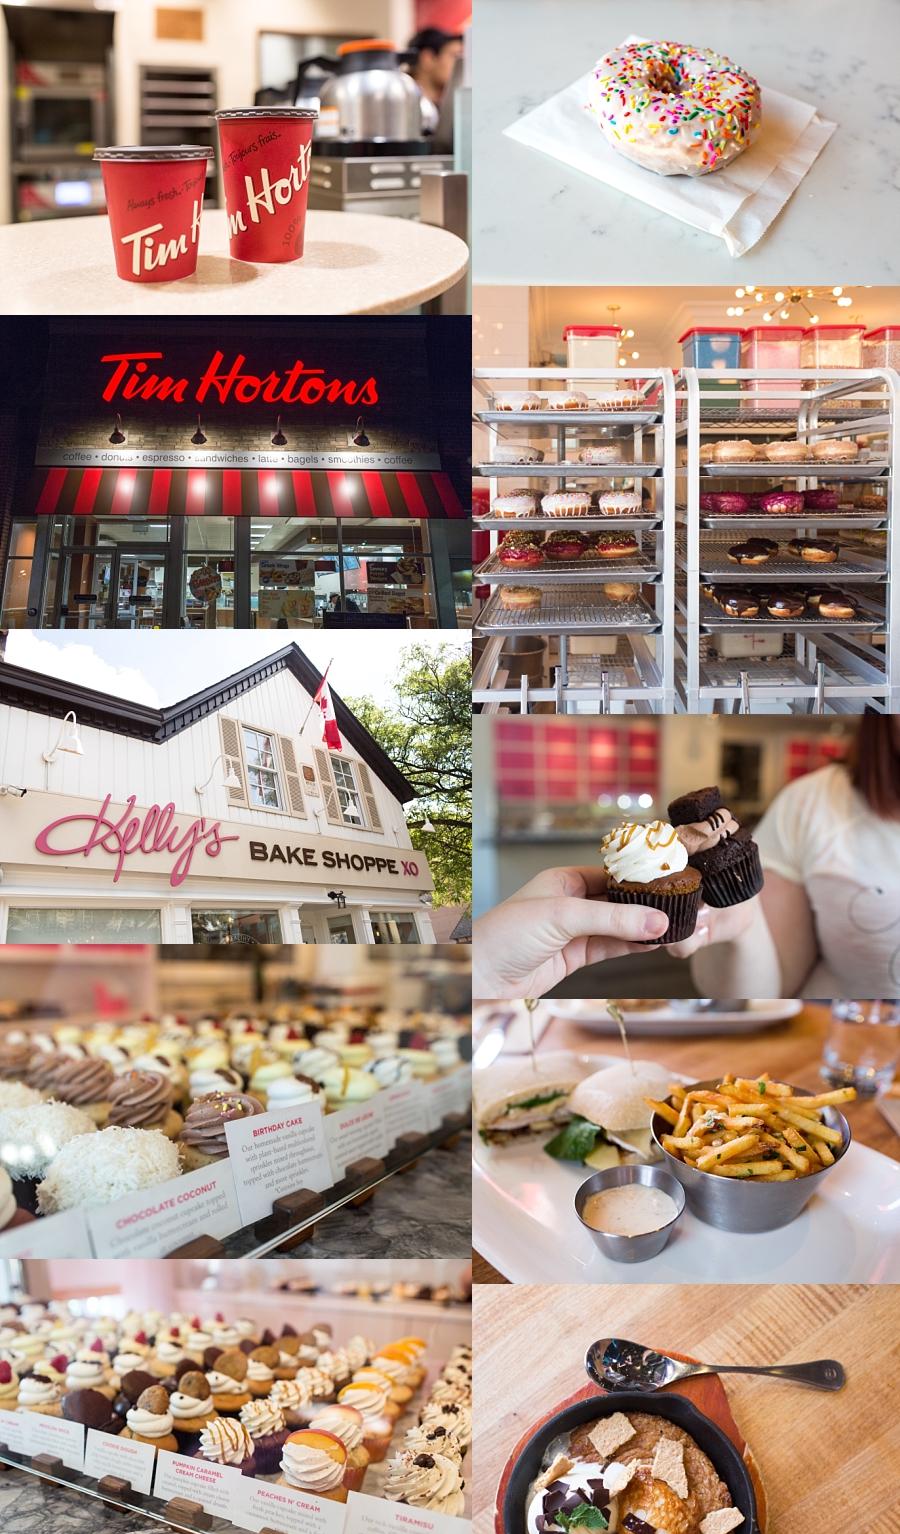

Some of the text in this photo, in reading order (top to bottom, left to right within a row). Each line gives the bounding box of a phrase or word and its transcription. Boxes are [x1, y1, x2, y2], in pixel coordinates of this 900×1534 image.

[245, 139, 312, 223] Hort
[127, 198, 156, 211] Always
[121, 223, 188, 276] Tim
[101, 350, 379, 406] Tim Hortons
[63, 452, 92, 461] coffee
[142, 453, 185, 464] espresso
[287, 455, 319, 465] bagels
[384, 456, 413, 465] coffee
[35, 793, 240, 888] Kelly's
[249, 840, 419, 877] BAKE SHOPPE XO
[252, 1117, 303, 1138] BIRTHDAY CAKE
[115, 1181, 217, 1229] CHOCOLATE COCONUT
[172, 1460, 224, 1478] PUMPKIN CARAMEL
[175, 1468, 217, 1484] CREAM CHEESE
[257, 1489, 287, 1503] PEACHES
[296, 1501, 321, 1512] CREAM
[395, 1514, 434, 1530] TIRAMISU
